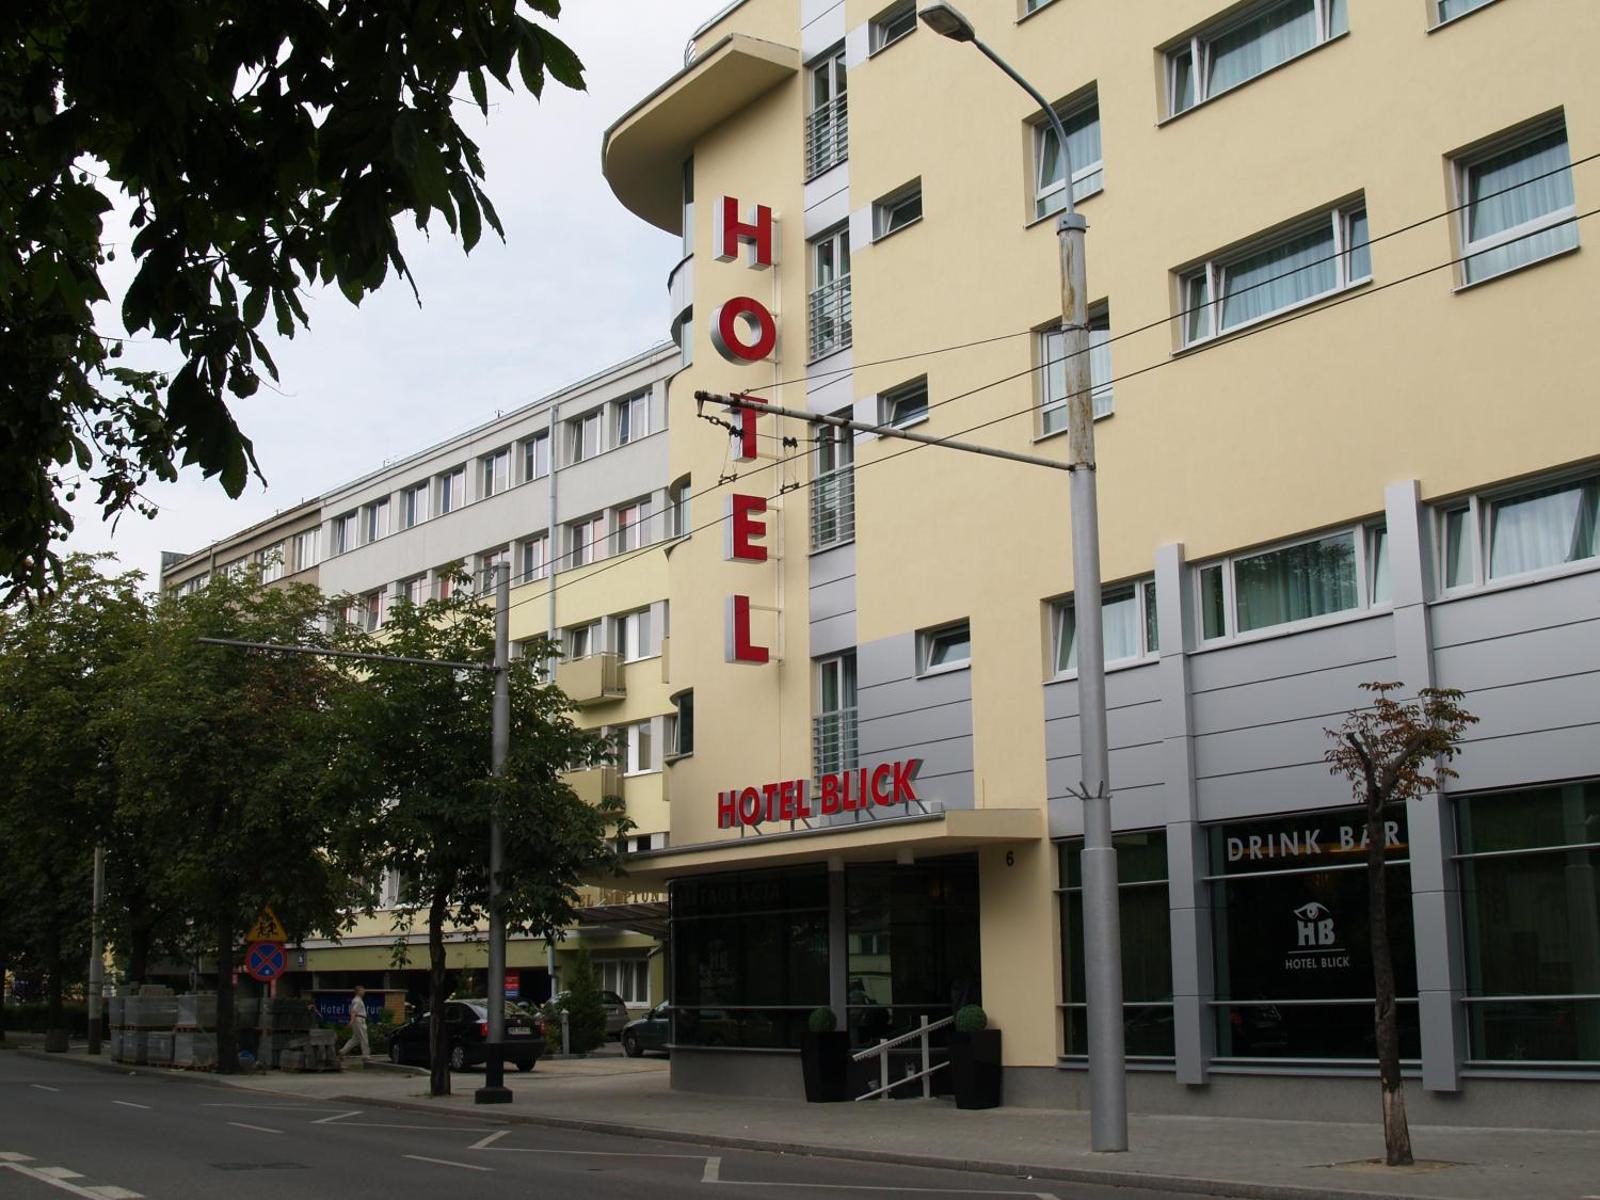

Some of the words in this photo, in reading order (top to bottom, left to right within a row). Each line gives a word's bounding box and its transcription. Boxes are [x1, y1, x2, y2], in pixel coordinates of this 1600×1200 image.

[713, 195, 776, 665] HOTEL
[718, 779, 812, 829] HOTEL
[821, 759, 921, 816] BLICK
[1006, 850, 1014, 867] 6
[1227, 829, 1322, 862] DRINK
[1297, 918, 1336, 946] HB
[1285, 958, 1317, 969] HOTEL
[1321, 956, 1350, 968] BLICK
[320, 1002, 345, 1015] Hotel
